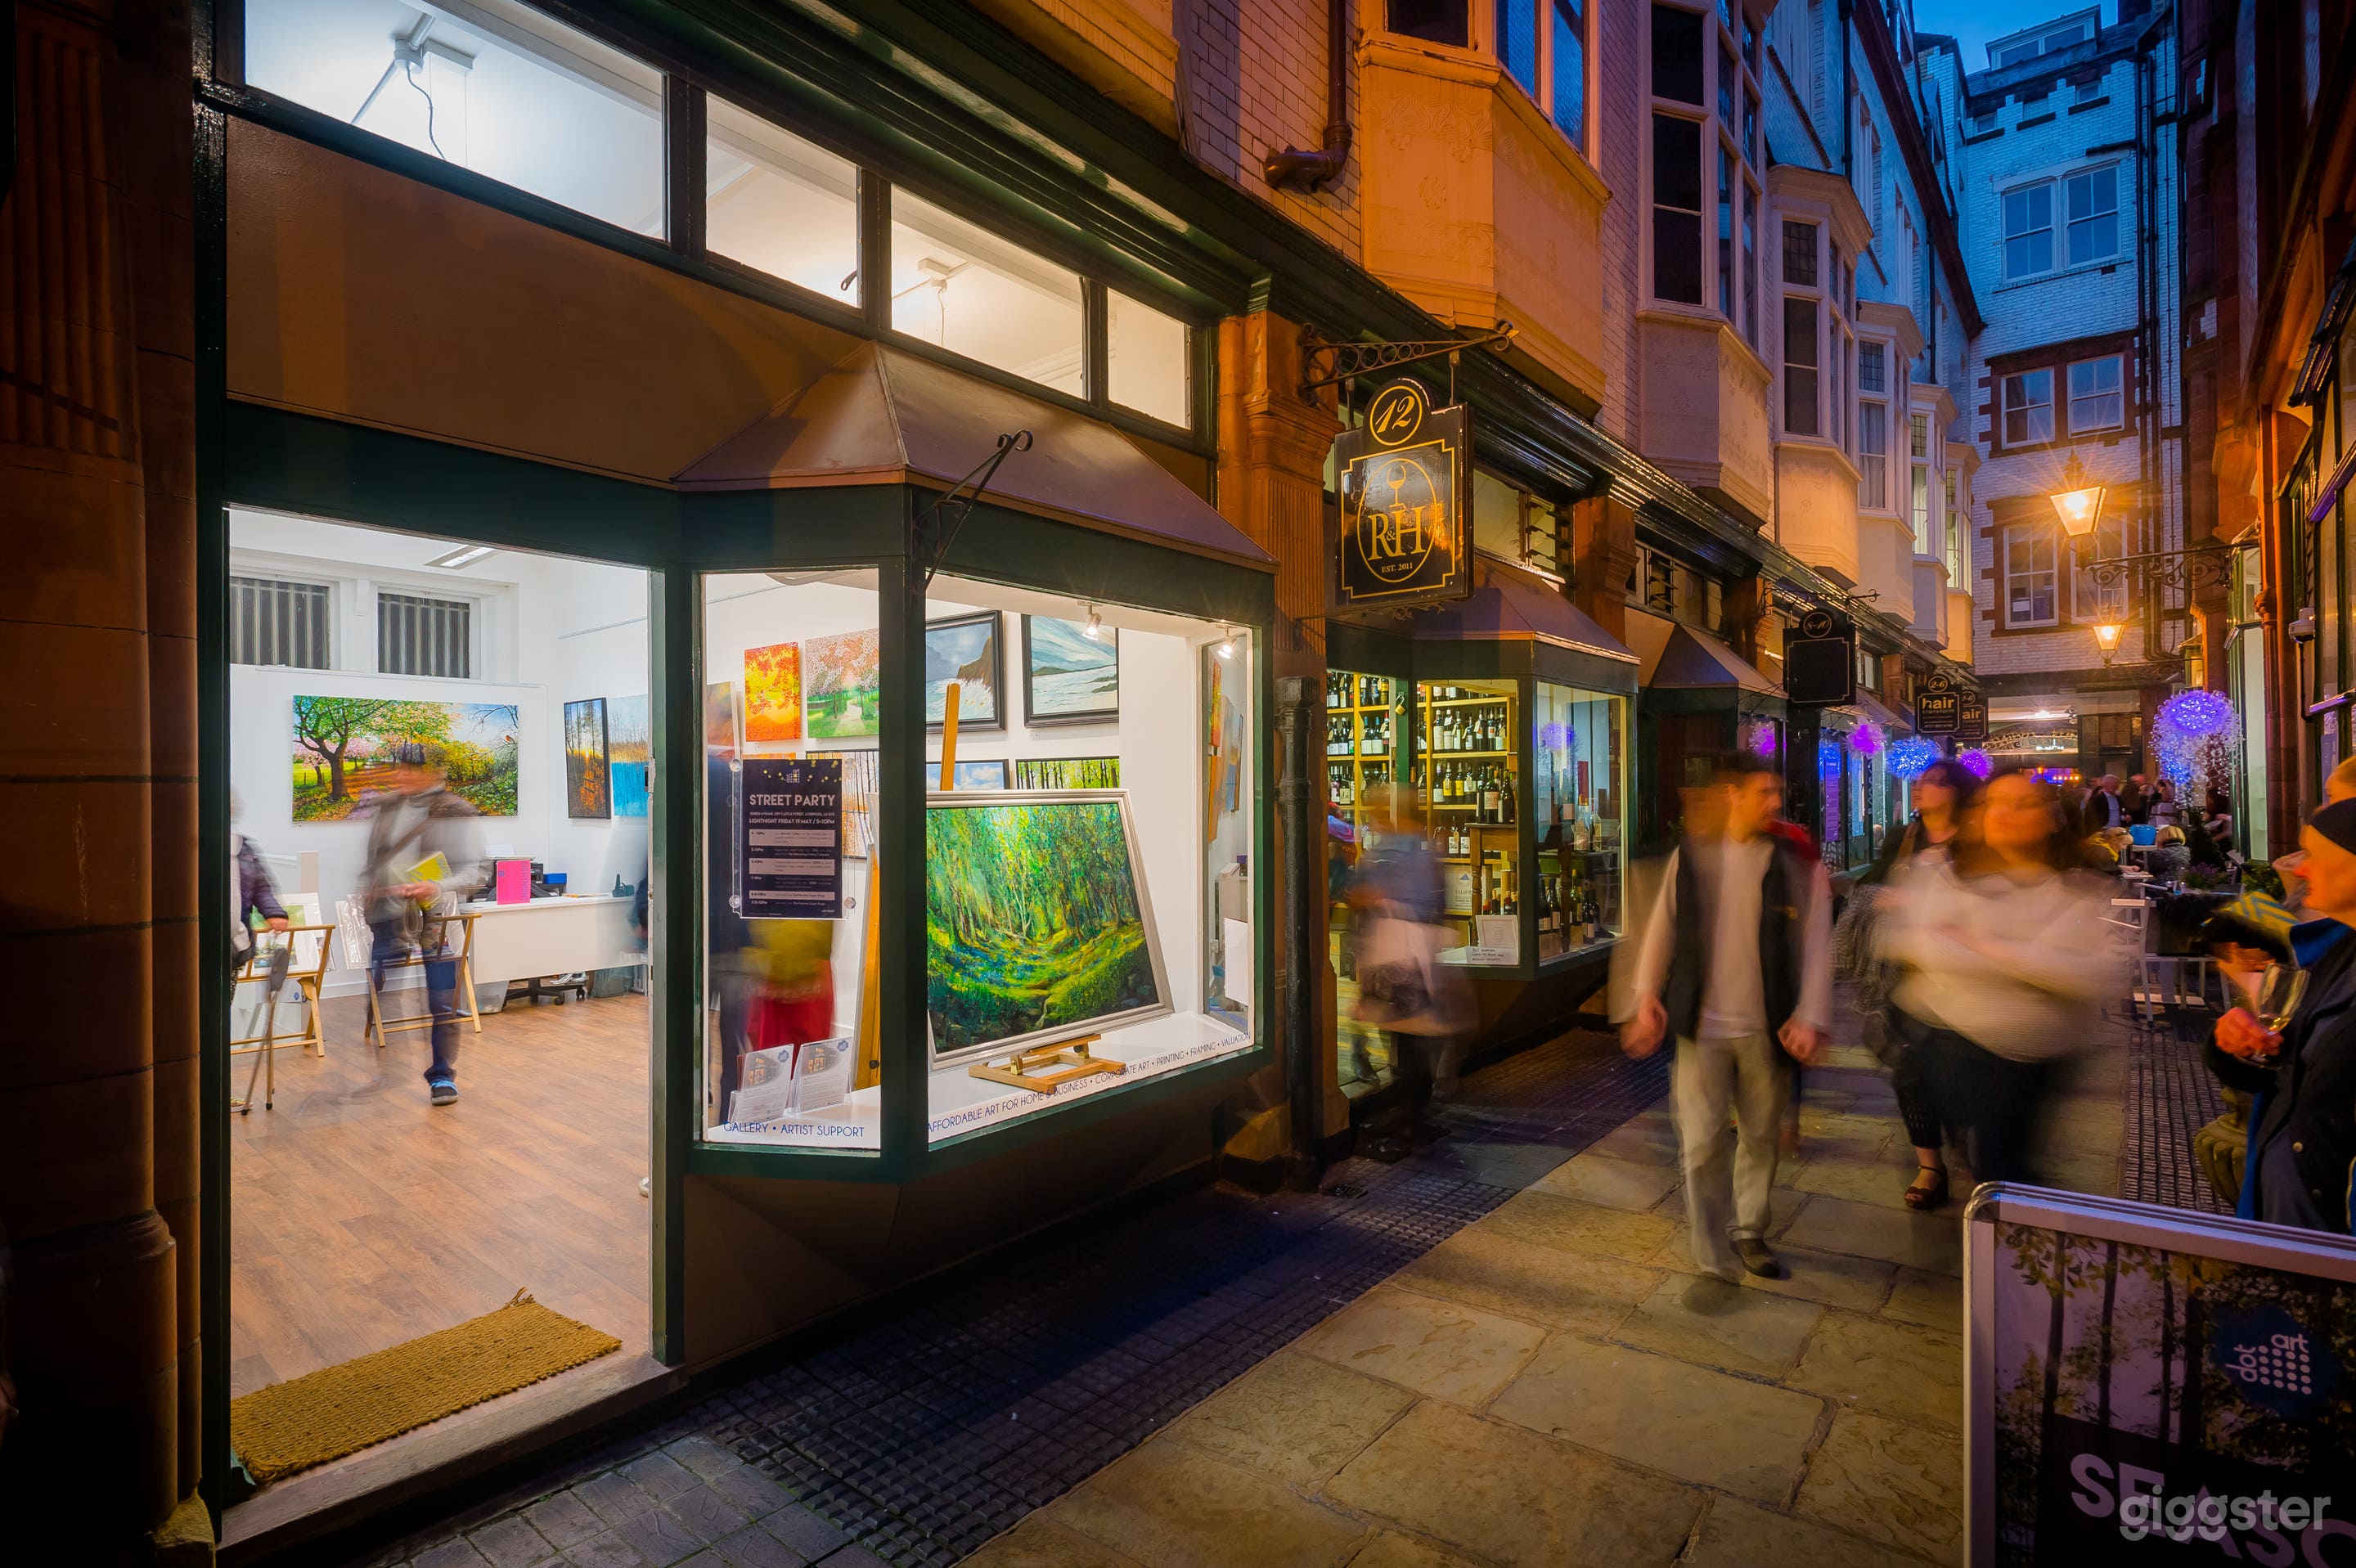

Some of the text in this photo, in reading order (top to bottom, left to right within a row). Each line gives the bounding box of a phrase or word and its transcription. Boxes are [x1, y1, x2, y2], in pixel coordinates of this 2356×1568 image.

[1375, 396, 1415, 433] 12
[1382, 563, 1413, 573] EST. 2011
[1922, 697, 1954, 709] hair
[749, 794, 835, 806] STREET PARTY
[928, 1108, 982, 1133] AFFORDABLE
[984, 1104, 1000, 1117] ART
[1002, 1098, 1018, 1112] FOR
[1021, 1091, 1044, 1106] HOME
[1045, 1090, 1051, 1098] &
[1054, 1079, 1088, 1097] BUSINESS
[1095, 1065, 1136, 1085] CORPORATE
[1138, 1061, 1150, 1074] ART
[1156, 1051, 1185, 1067] PRINTING
[1190, 1042, 1216, 1057] FRAMING
[724, 1122, 865, 1138] GALLERY ARTIST SUPPORT
[2271, 1333, 2309, 1354] art
[2225, 1344, 2258, 1382] dot
